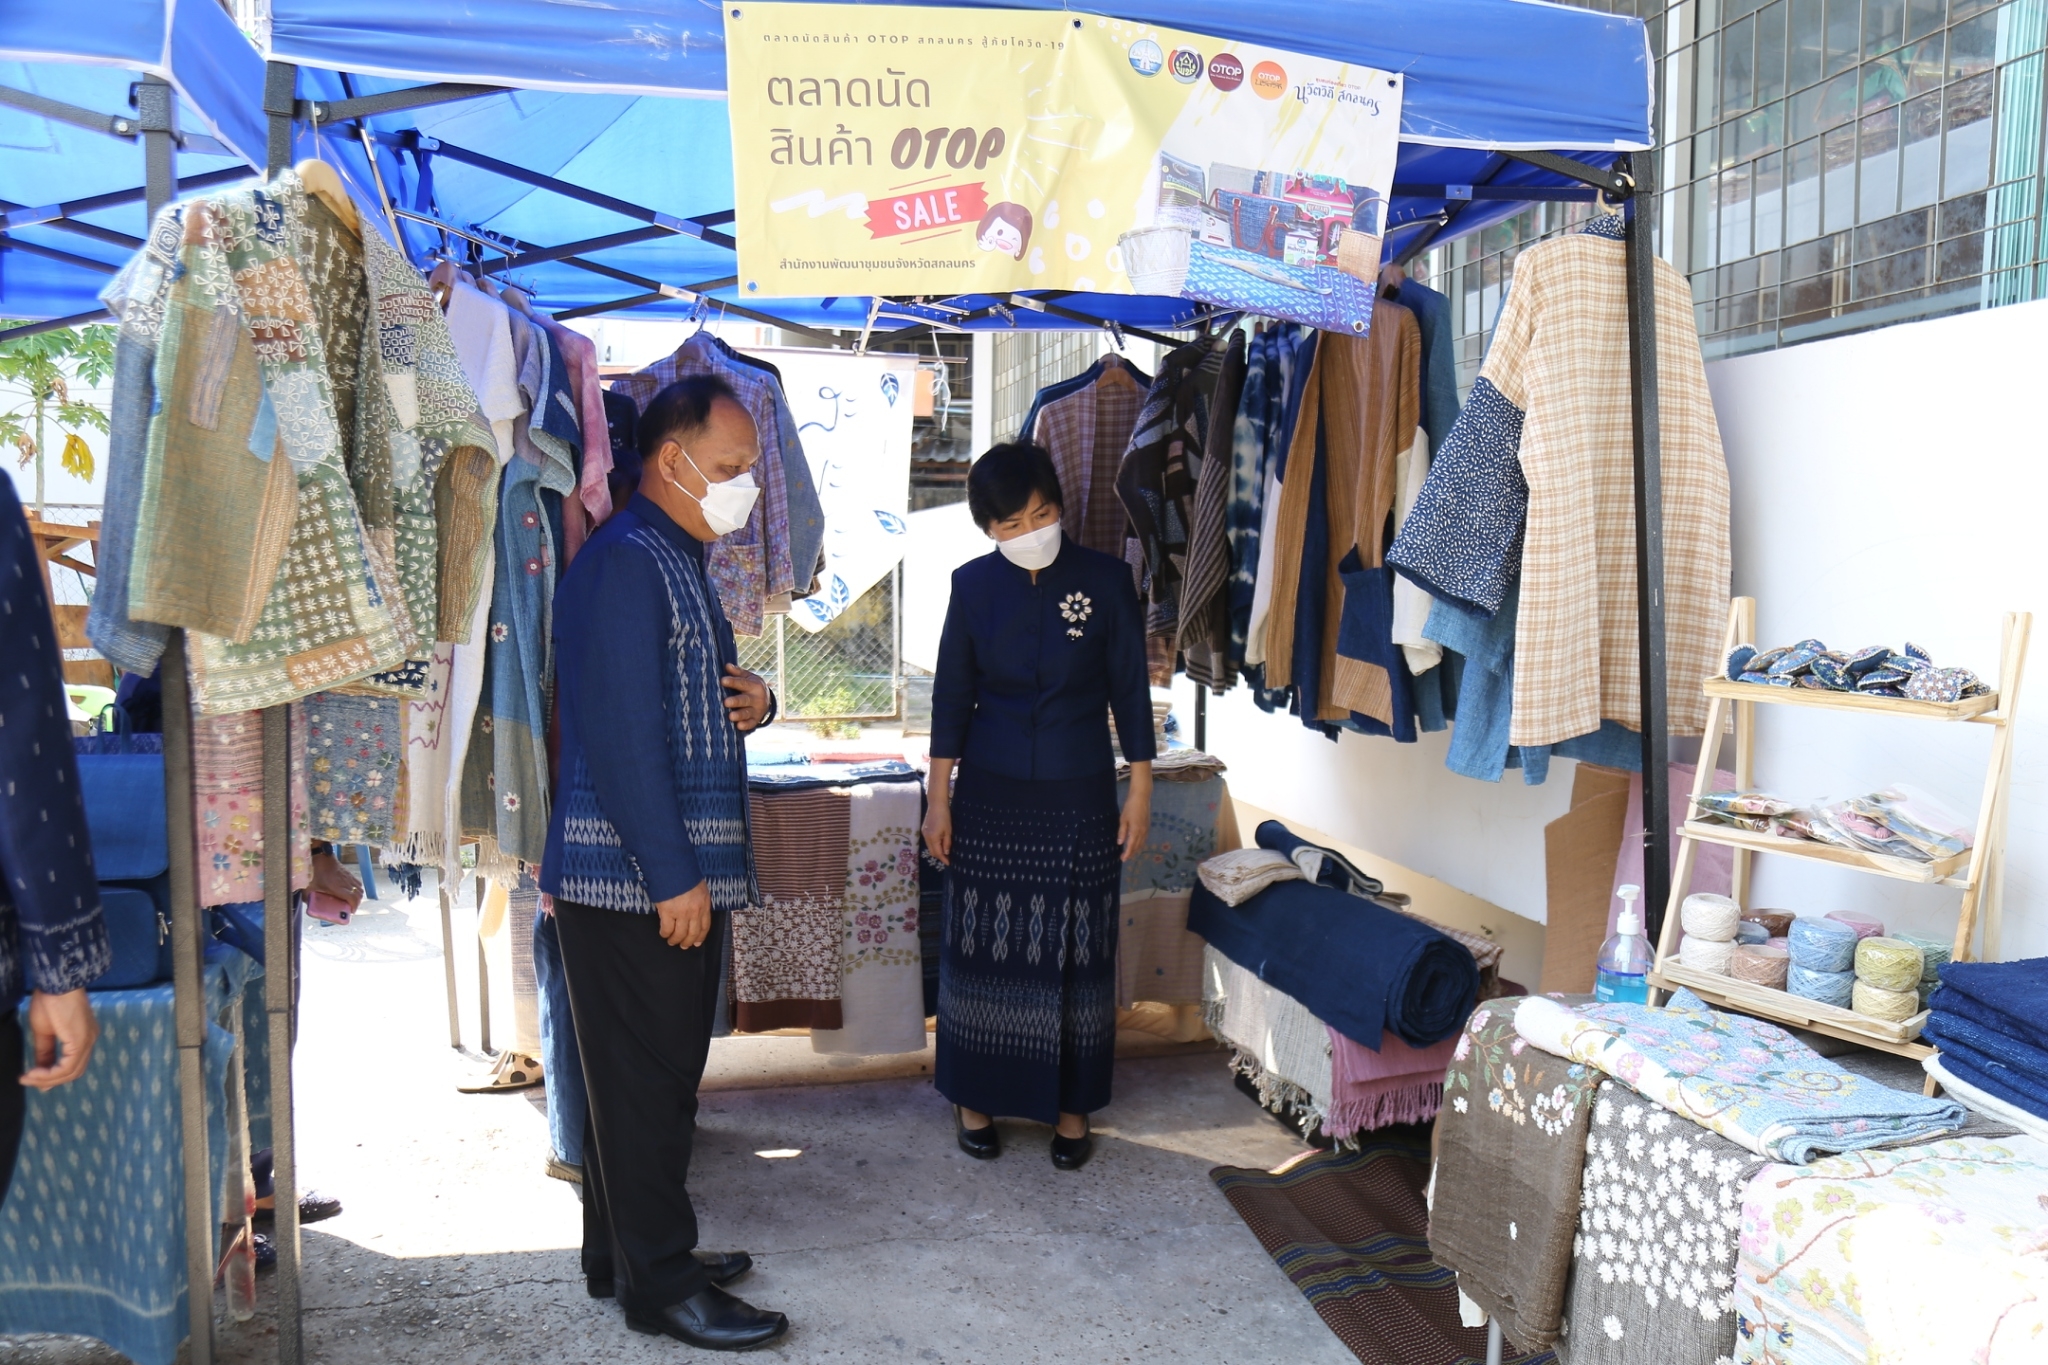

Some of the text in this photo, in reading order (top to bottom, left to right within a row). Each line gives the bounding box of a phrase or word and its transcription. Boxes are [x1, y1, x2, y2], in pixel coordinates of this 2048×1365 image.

[763, 33, 859, 43] ตลาดนัดสินค้า
[867, 34, 909, 44] OTOP
[918, 36, 973, 46] สกลนคร
[1211, 63, 1242, 77] OTOP
[1258, 72, 1281, 82] OTOP
[767, 67, 931, 107] ตลาดนัด
[770, 123, 1006, 170] สินค้า OTOP
[892, 190, 962, 231] SALE
[779, 257, 976, 271] สำนักงานพัฒนาชุมชนจังหวัดสกลนคร
